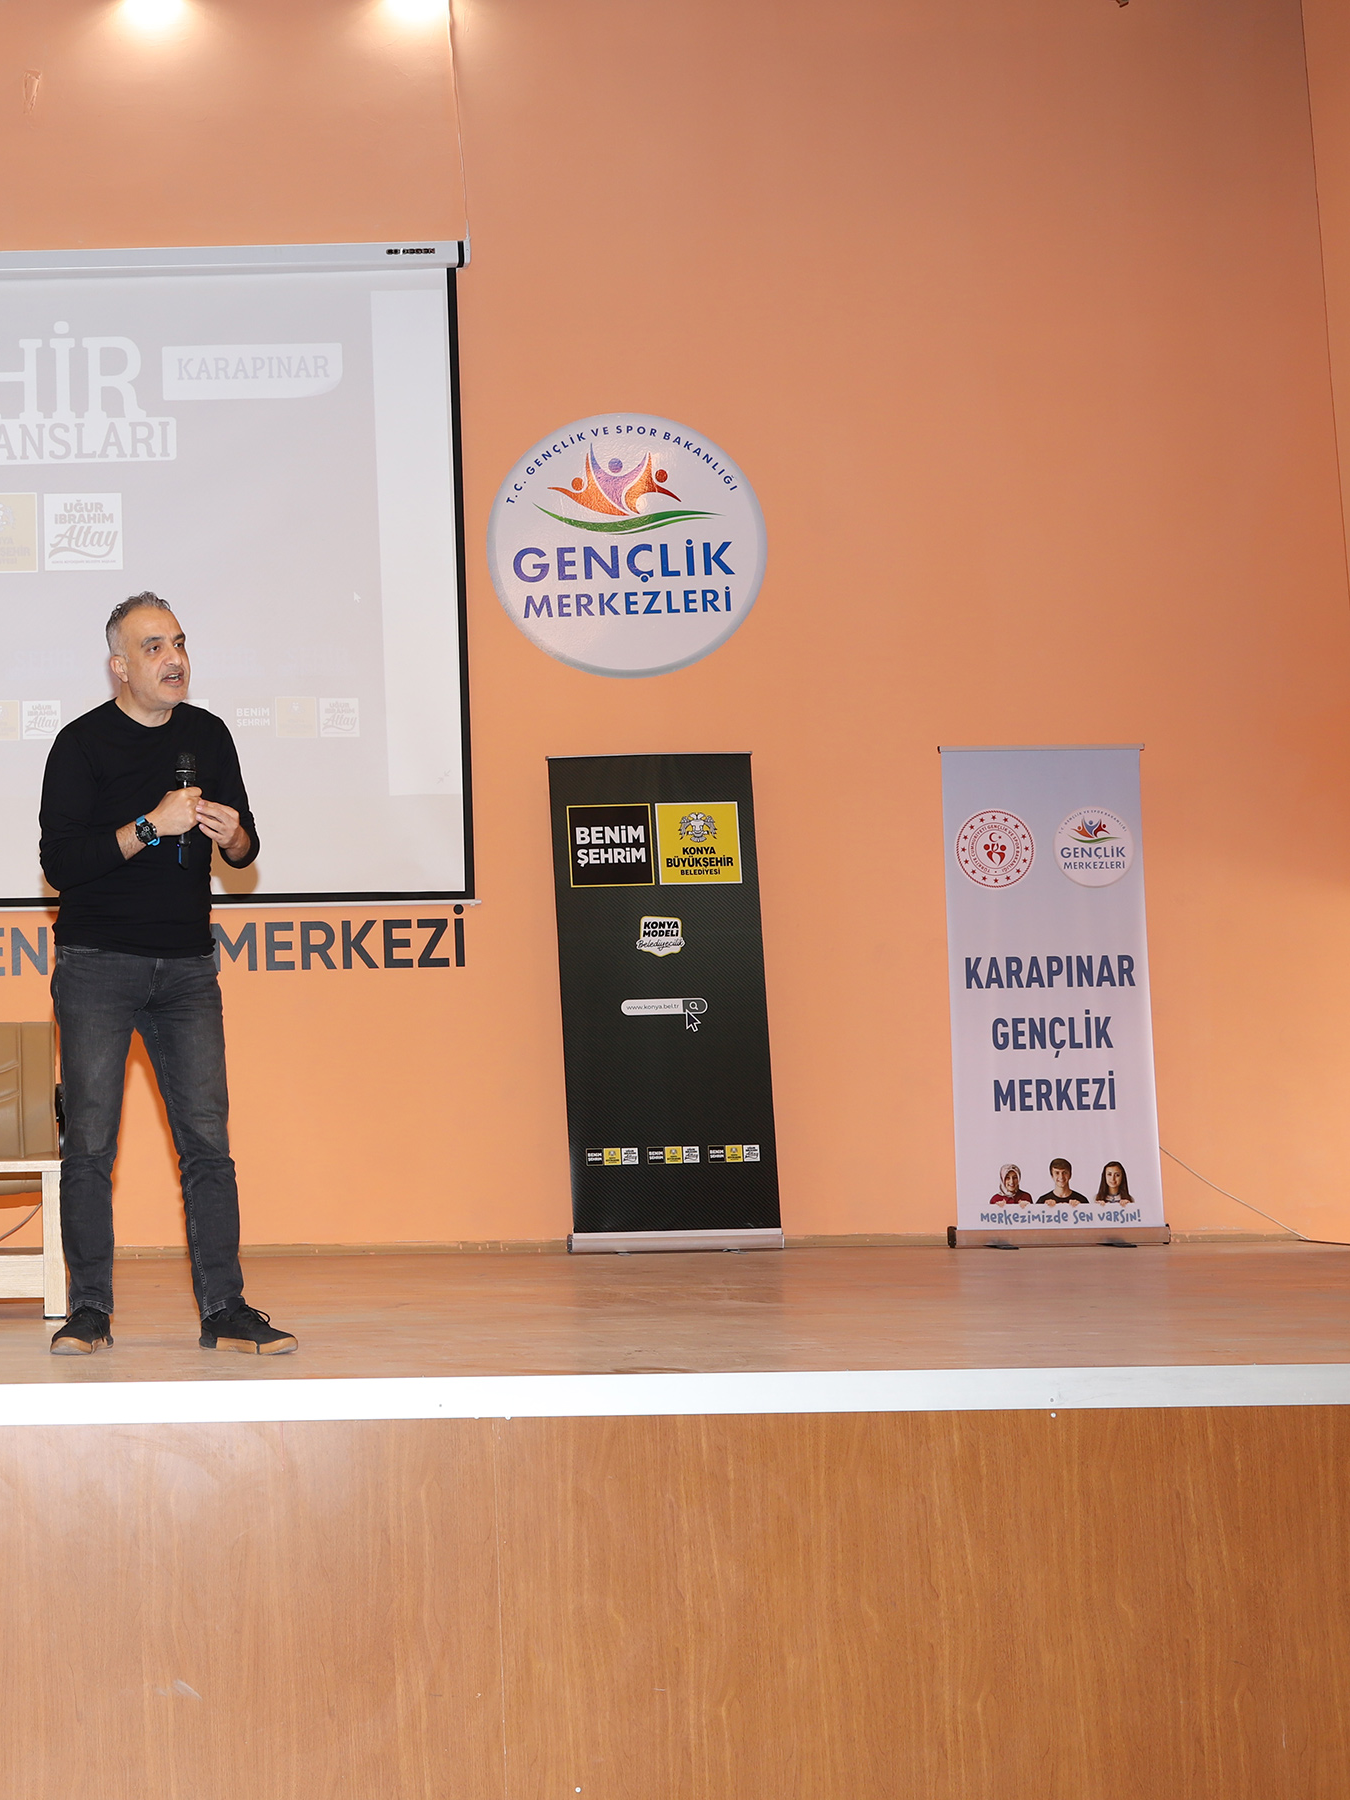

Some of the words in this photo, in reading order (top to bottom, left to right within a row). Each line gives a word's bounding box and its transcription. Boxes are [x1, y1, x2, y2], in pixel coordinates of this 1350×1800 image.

[177, 355, 330, 381] KARAPINAR
[526, 433, 585, 476] GENÇLİK
[591, 426, 609, 438] VE
[616, 425, 657, 437] SPOR
[662, 431, 738, 492] BAKANLIĞI
[63, 500, 104, 513] UĞUR
[49, 525, 118, 558] Altay
[512, 539, 735, 583] GENÇLİK
[523, 586, 732, 619] MERKEZLERİ
[666, 855, 734, 868] BÜYÜKŞEHİR
[682, 846, 716, 855] KONYA
[1060, 845, 1126, 859] GENÇLİK
[680, 868, 721, 876] BELEDİYESİ
[210, 904, 466, 972] MERKEZİ
[643, 921, 679, 929] KONYA
[964, 954, 1136, 989] KARAPINAR
[991, 1009, 1114, 1058] GENÇLİK
[993, 1070, 1116, 1112] MERKEZİ
